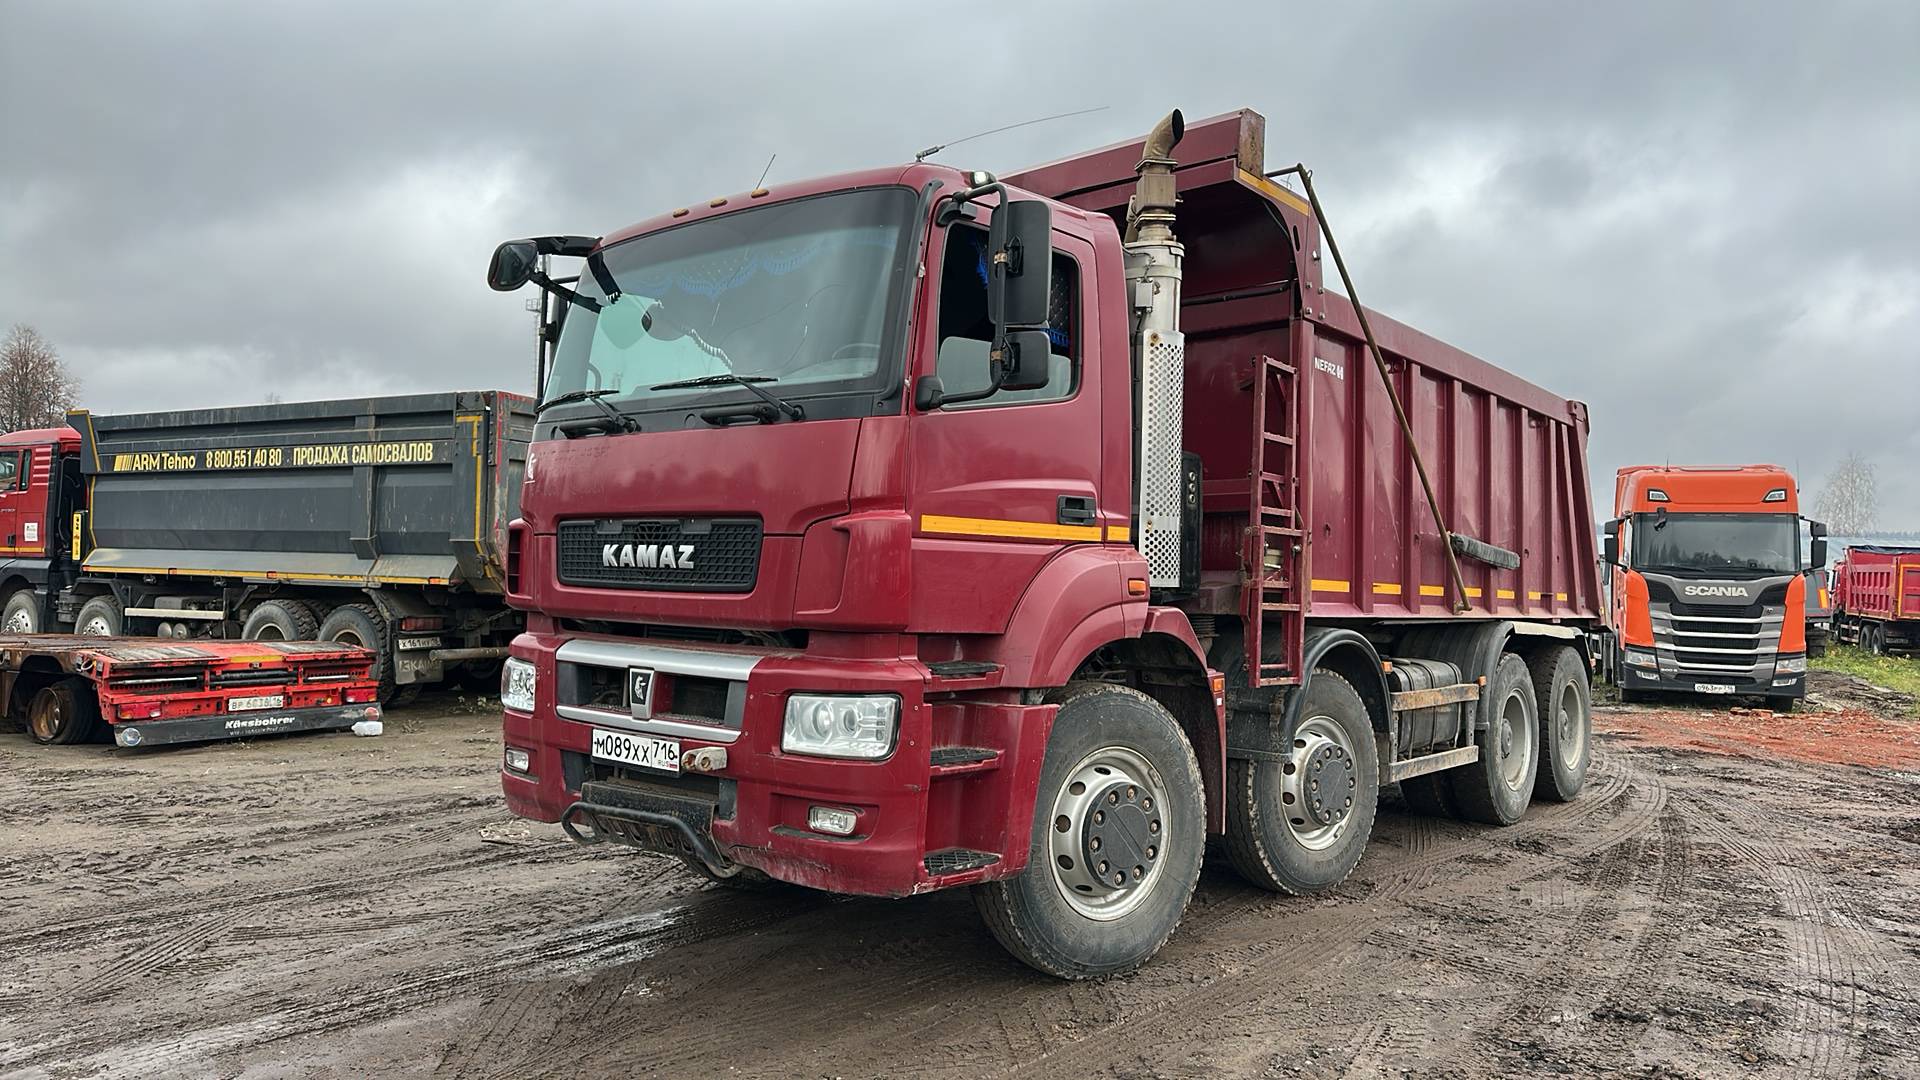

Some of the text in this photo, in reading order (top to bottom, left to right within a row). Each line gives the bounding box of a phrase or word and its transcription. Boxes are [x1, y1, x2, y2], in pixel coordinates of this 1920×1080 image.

[1314, 356, 1336, 376] NEFAZ
[132, 452, 196, 471] ARM Tehno
[206, 448, 281, 468] 8 800 551 40 80
[293, 442, 433, 466] ПРОДАЖА САМОСВАЛОВ
[602, 544, 694, 569] KAMAZ
[1684, 586, 1748, 597] SCANIA
[653, 741, 676, 761] 716
[658, 759, 670, 768] RUS
